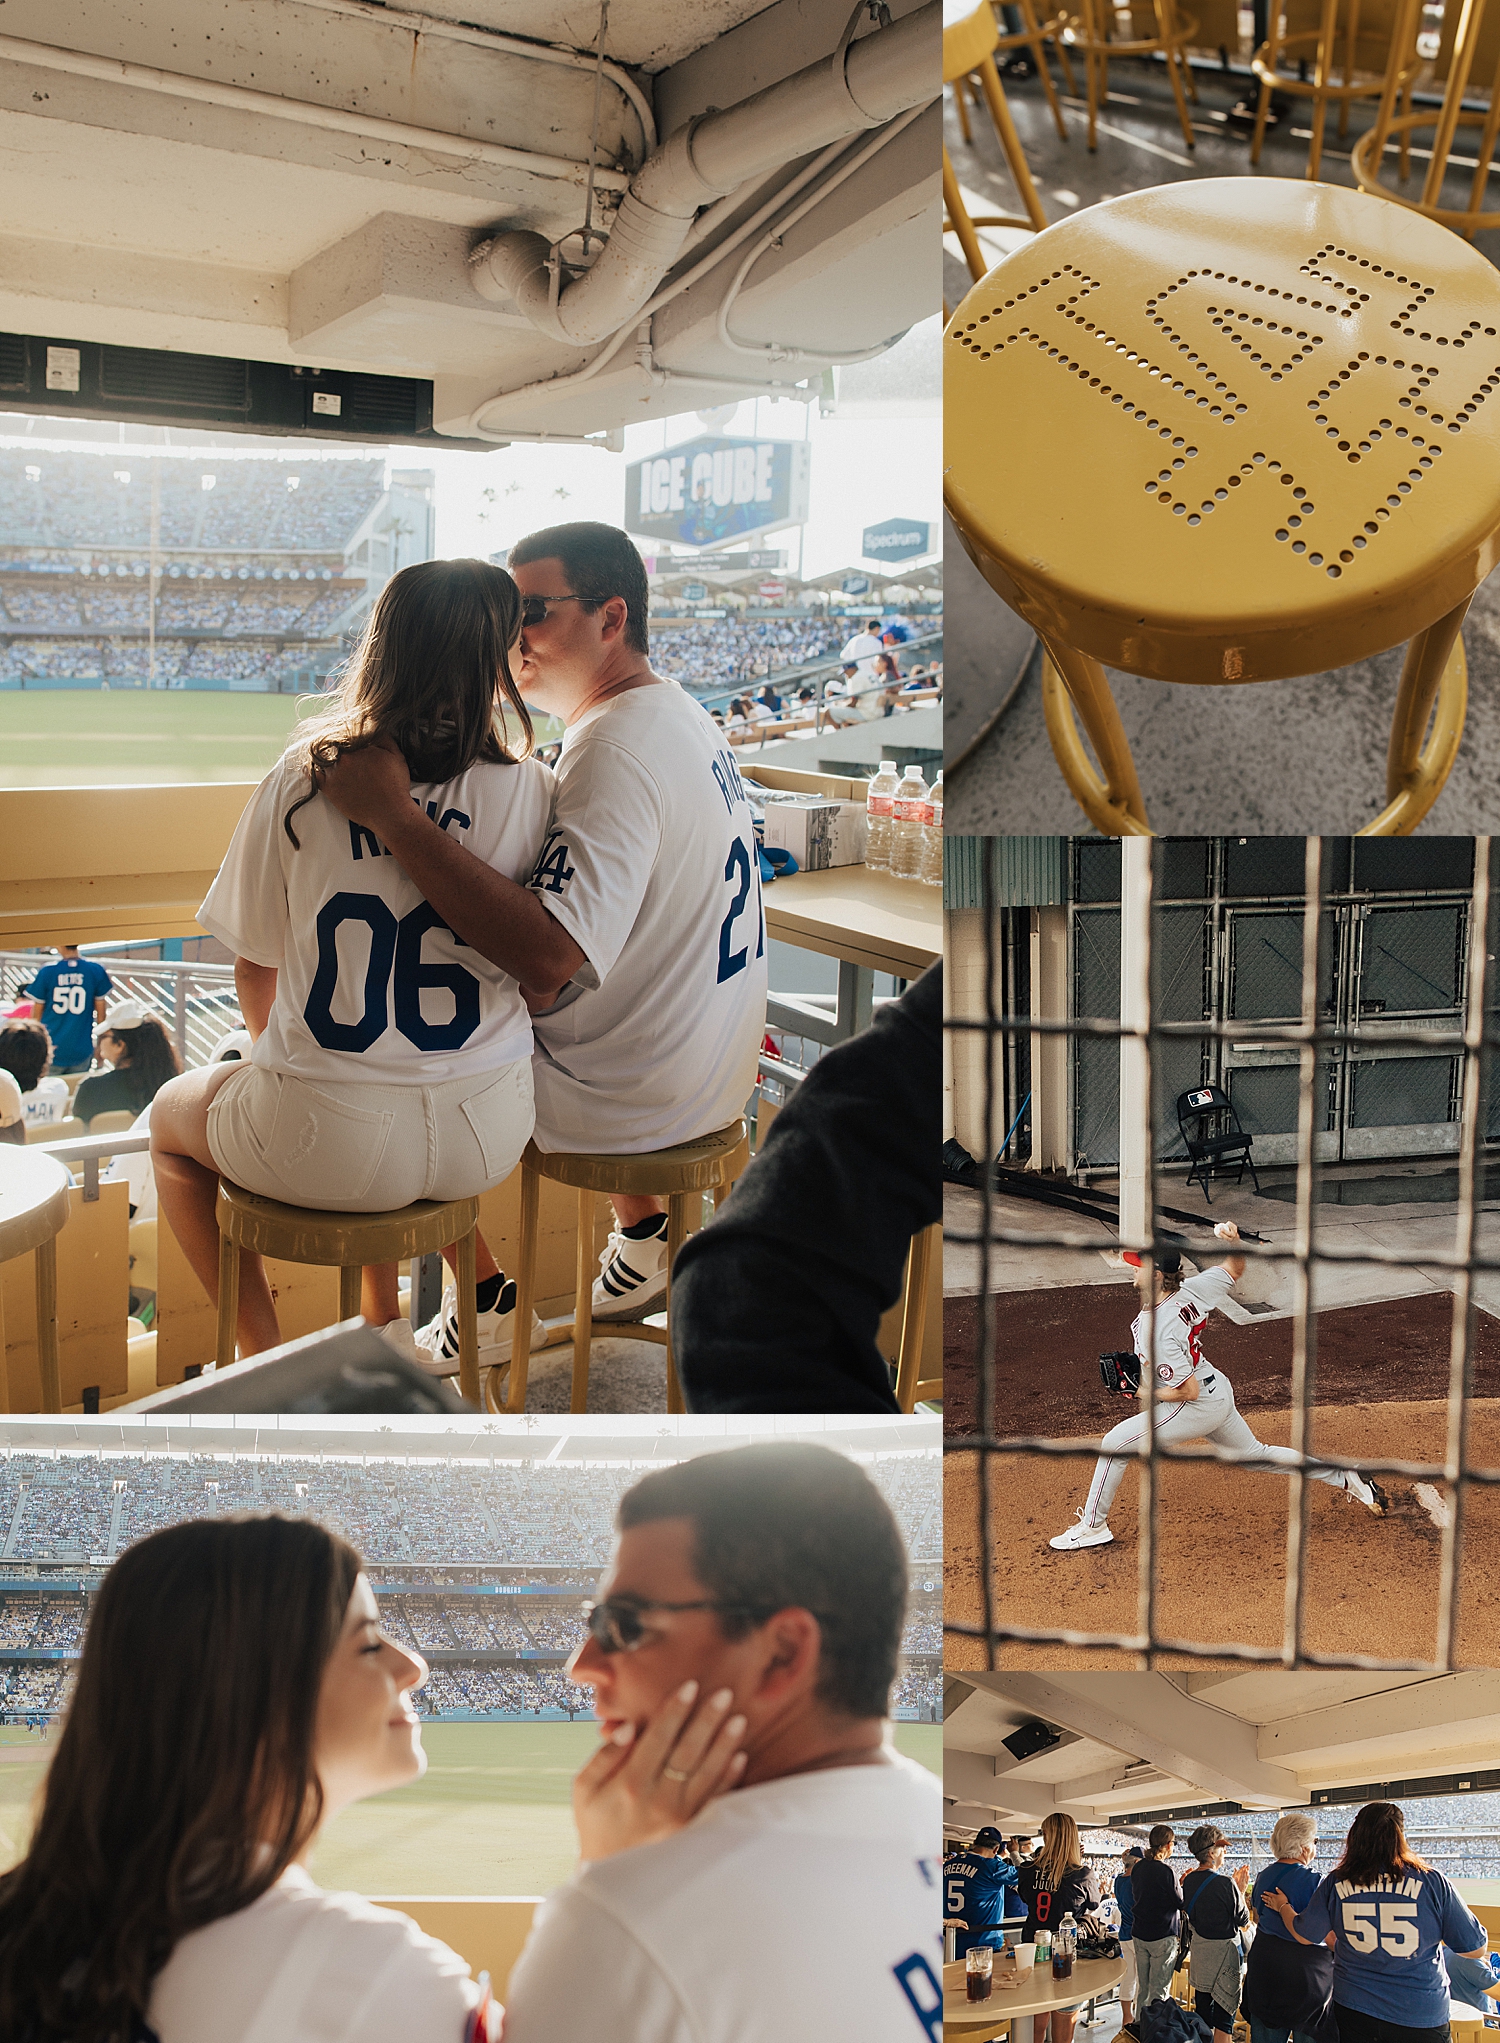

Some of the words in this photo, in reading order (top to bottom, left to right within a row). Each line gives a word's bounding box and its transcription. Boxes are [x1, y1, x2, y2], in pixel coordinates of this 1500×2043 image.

[640, 456, 686, 514] ICE
[690, 443, 775, 507] CUBE
[863, 532, 921, 552] Spectrum
[303, 891, 482, 1054] 06
[52, 985, 87, 1015] 50
[947, 1880, 965, 1912] 5
[1036, 1891, 1052, 1922] 8
[1341, 1902, 1420, 1957] 55
